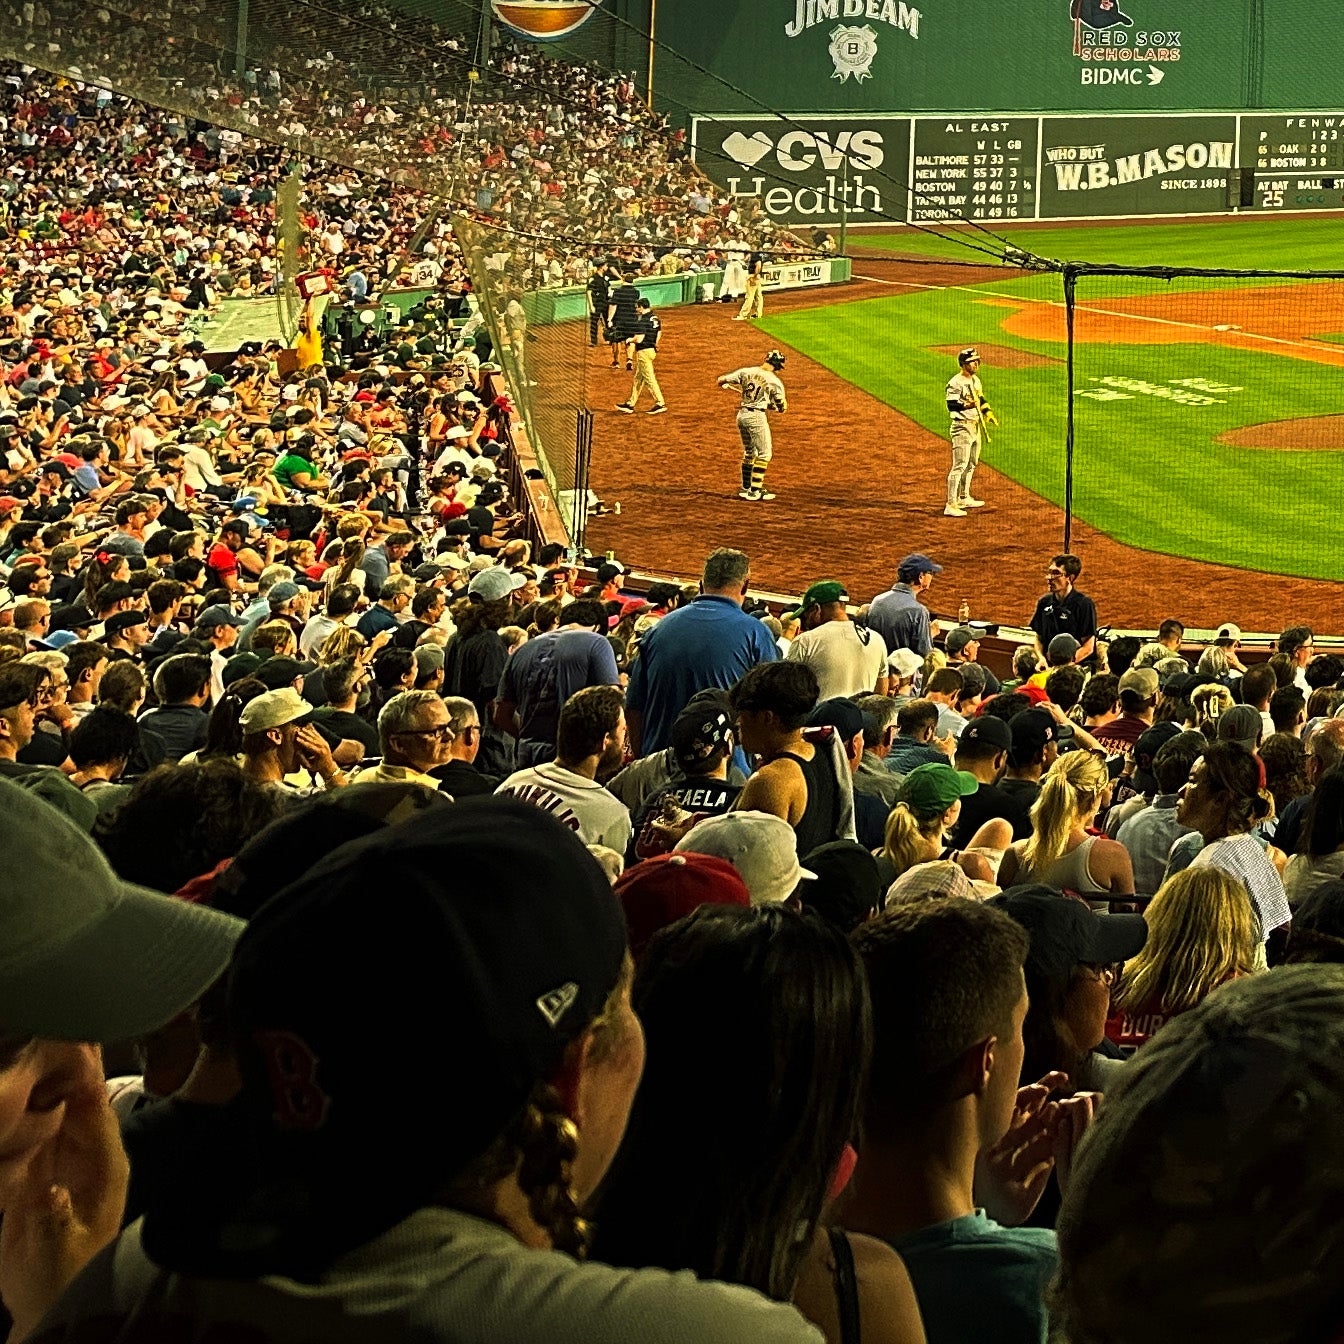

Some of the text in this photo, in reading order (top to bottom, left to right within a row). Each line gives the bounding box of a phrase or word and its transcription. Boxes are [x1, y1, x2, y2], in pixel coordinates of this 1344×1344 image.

[1083, 31, 1181, 47] RED SOX
[1080, 47, 1181, 62] SCHOLARS
[1081, 68, 1143, 85] BIDMC
[945, 122, 1010, 133] AL EAST
[776, 130, 884, 171] CVS
[1047, 146, 1105, 162] WHO BUT
[1279, 144, 1299, 154] OAK
[916, 154, 1003, 165] BALTIMORE 57 33
[1271, 158, 1306, 167] BOSTON
[1054, 141, 1234, 191] W.B.MASON
[916, 168, 1003, 179] NEW YORK 55 37
[916, 181, 1003, 192] BOSTON 49 40
[1161, 178, 1227, 189] SINCE 1898
[1258, 181, 1270, 191] AT
[1298, 179, 1323, 190] BALL
[727, 176, 884, 215] Health
[948, 195, 967, 205] BAY
[972, 194, 987, 204] 44
[989, 194, 1003, 204] 46
[1007, 193, 1018, 204] 13
[1262, 191, 1284, 208] 25
[973, 208, 985, 218] 41
[989, 207, 1003, 217] 49
[1006, 207, 1018, 217] 16
[419, 269, 433, 280] 34
[743, 382, 761, 401] 21
[654, 788, 729, 808] FAELA
